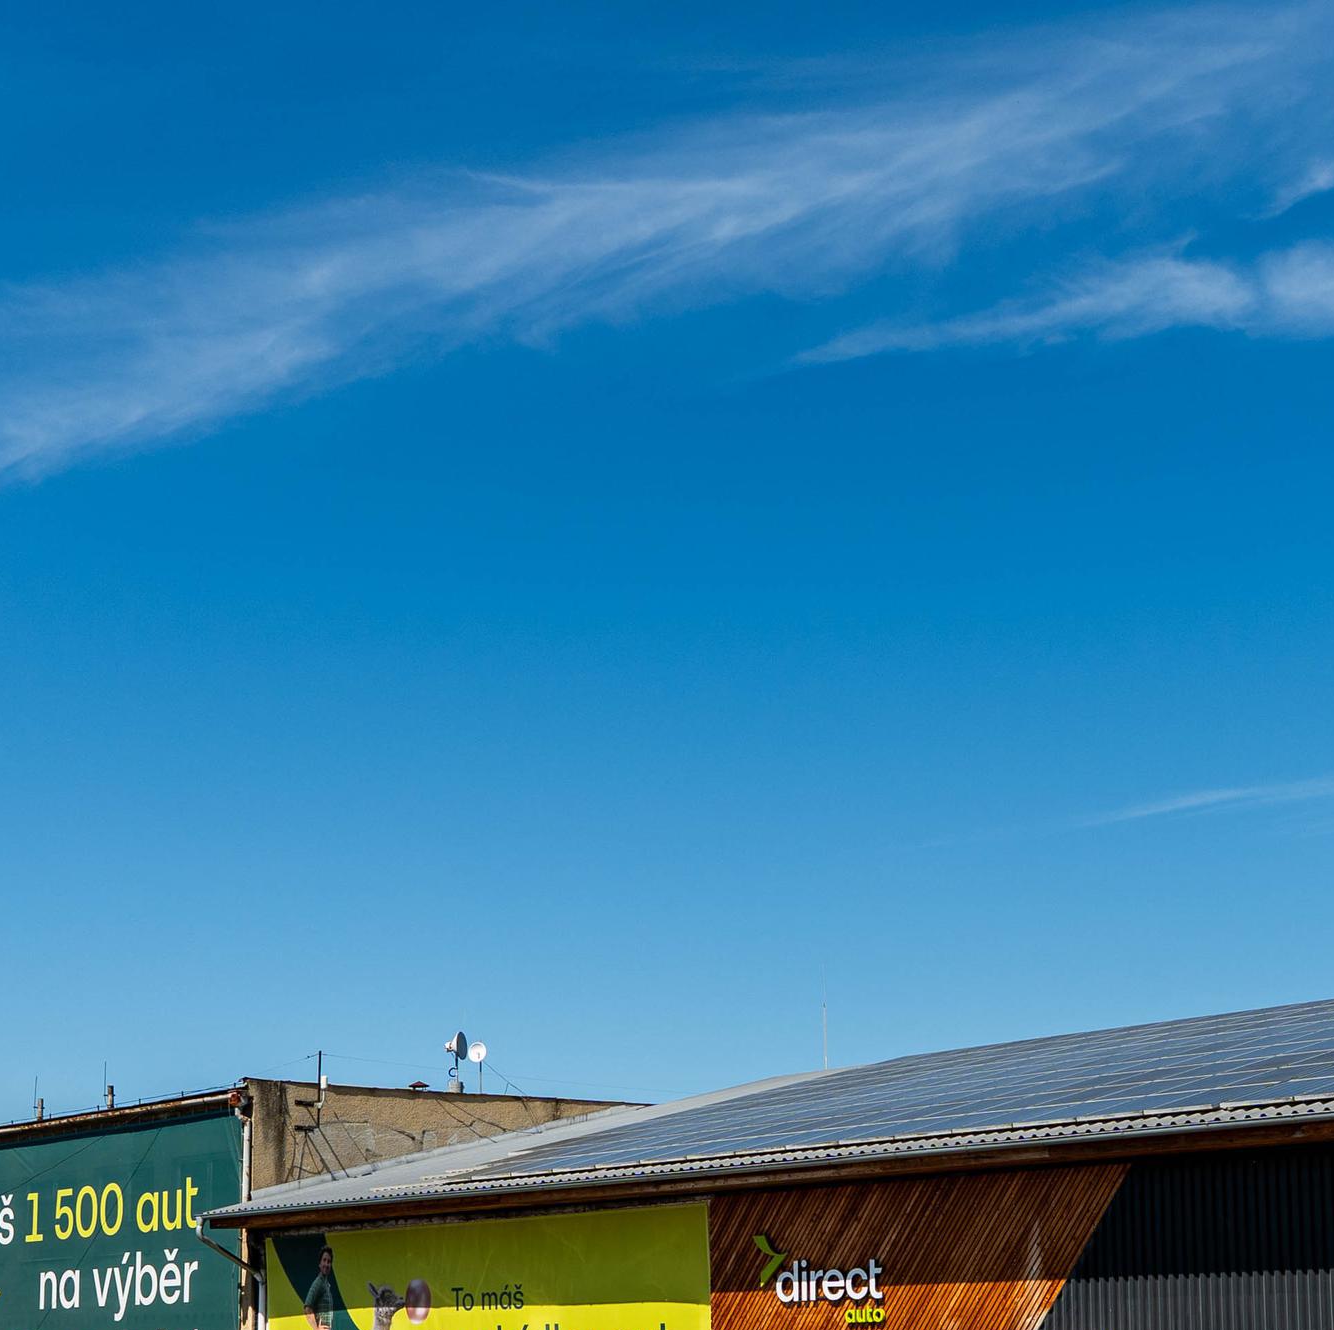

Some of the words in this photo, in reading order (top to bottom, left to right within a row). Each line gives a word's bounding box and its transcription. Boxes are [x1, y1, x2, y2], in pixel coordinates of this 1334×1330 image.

[25, 1192, 44, 1243] 1
[55, 1182, 124, 1241] 500
[136, 1177, 199, 1233] aut
[39, 1267, 80, 1310] na
[93, 1248, 199, 1322] výběr
[451, 1287, 474, 1311] To
[481, 1284, 524, 1310] máš
[776, 1258, 884, 1303] direct
[845, 1304, 886, 1324] auto
